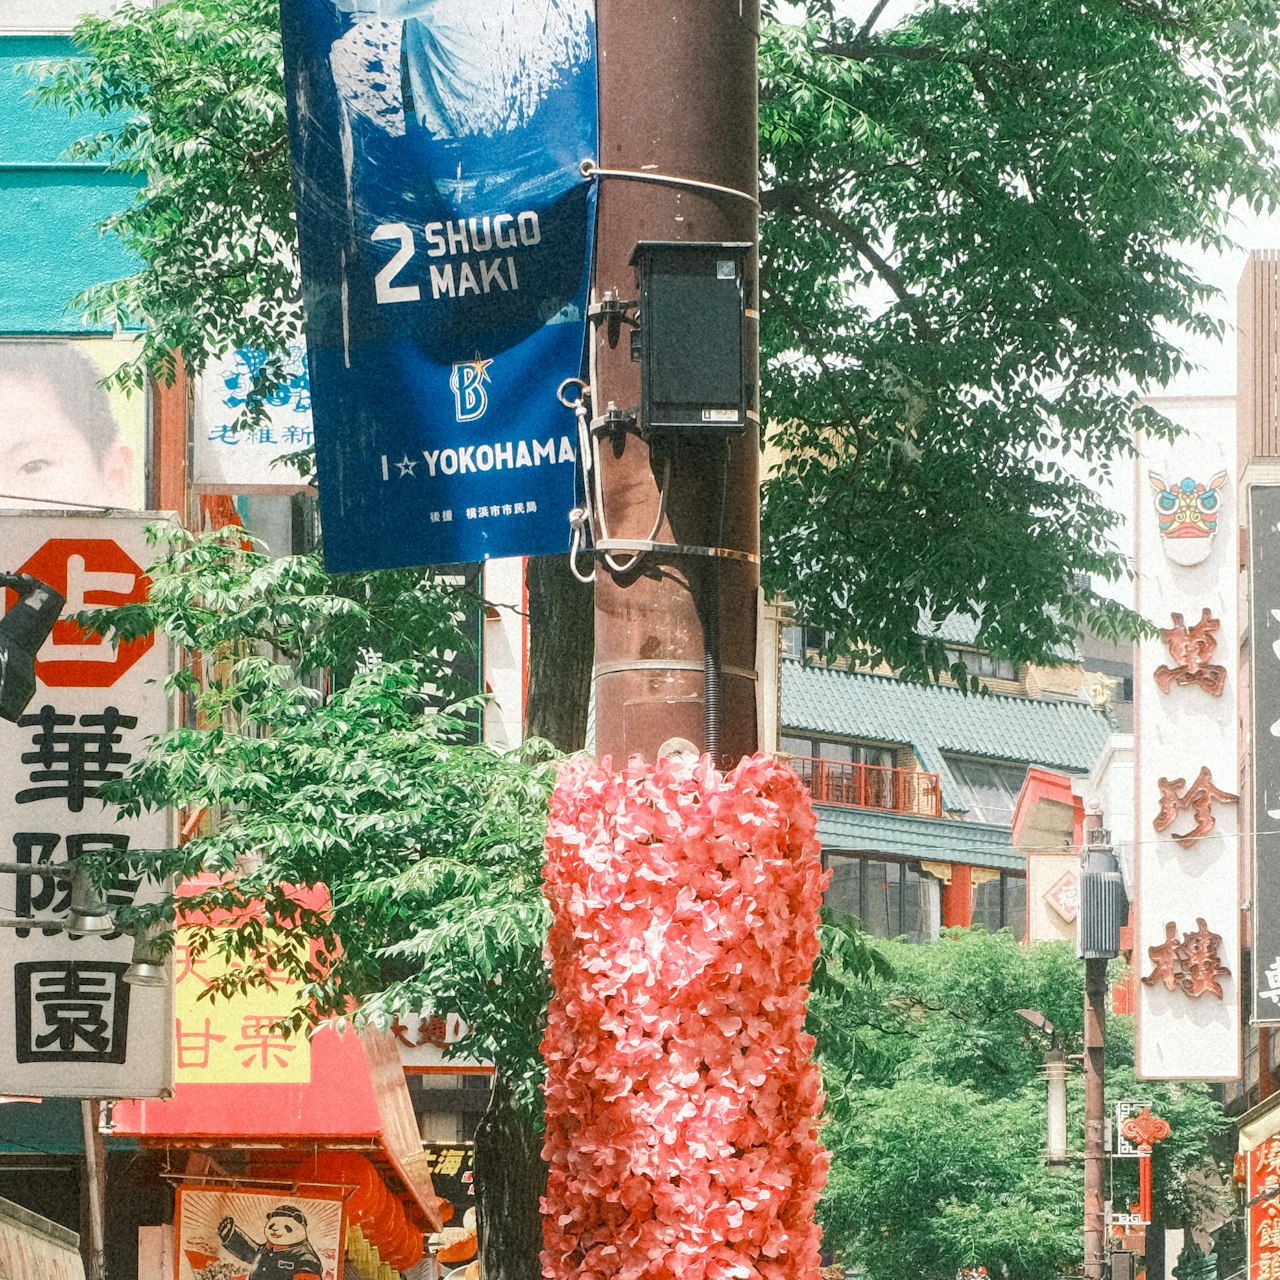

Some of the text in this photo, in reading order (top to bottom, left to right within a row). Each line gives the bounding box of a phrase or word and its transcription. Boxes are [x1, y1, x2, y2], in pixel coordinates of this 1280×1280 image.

[424, 210, 542, 257] SHUGO
[371, 221, 421, 305] 2
[429, 256, 519, 299] MAKI
[423, 435, 577, 478] YOKOHAMA
